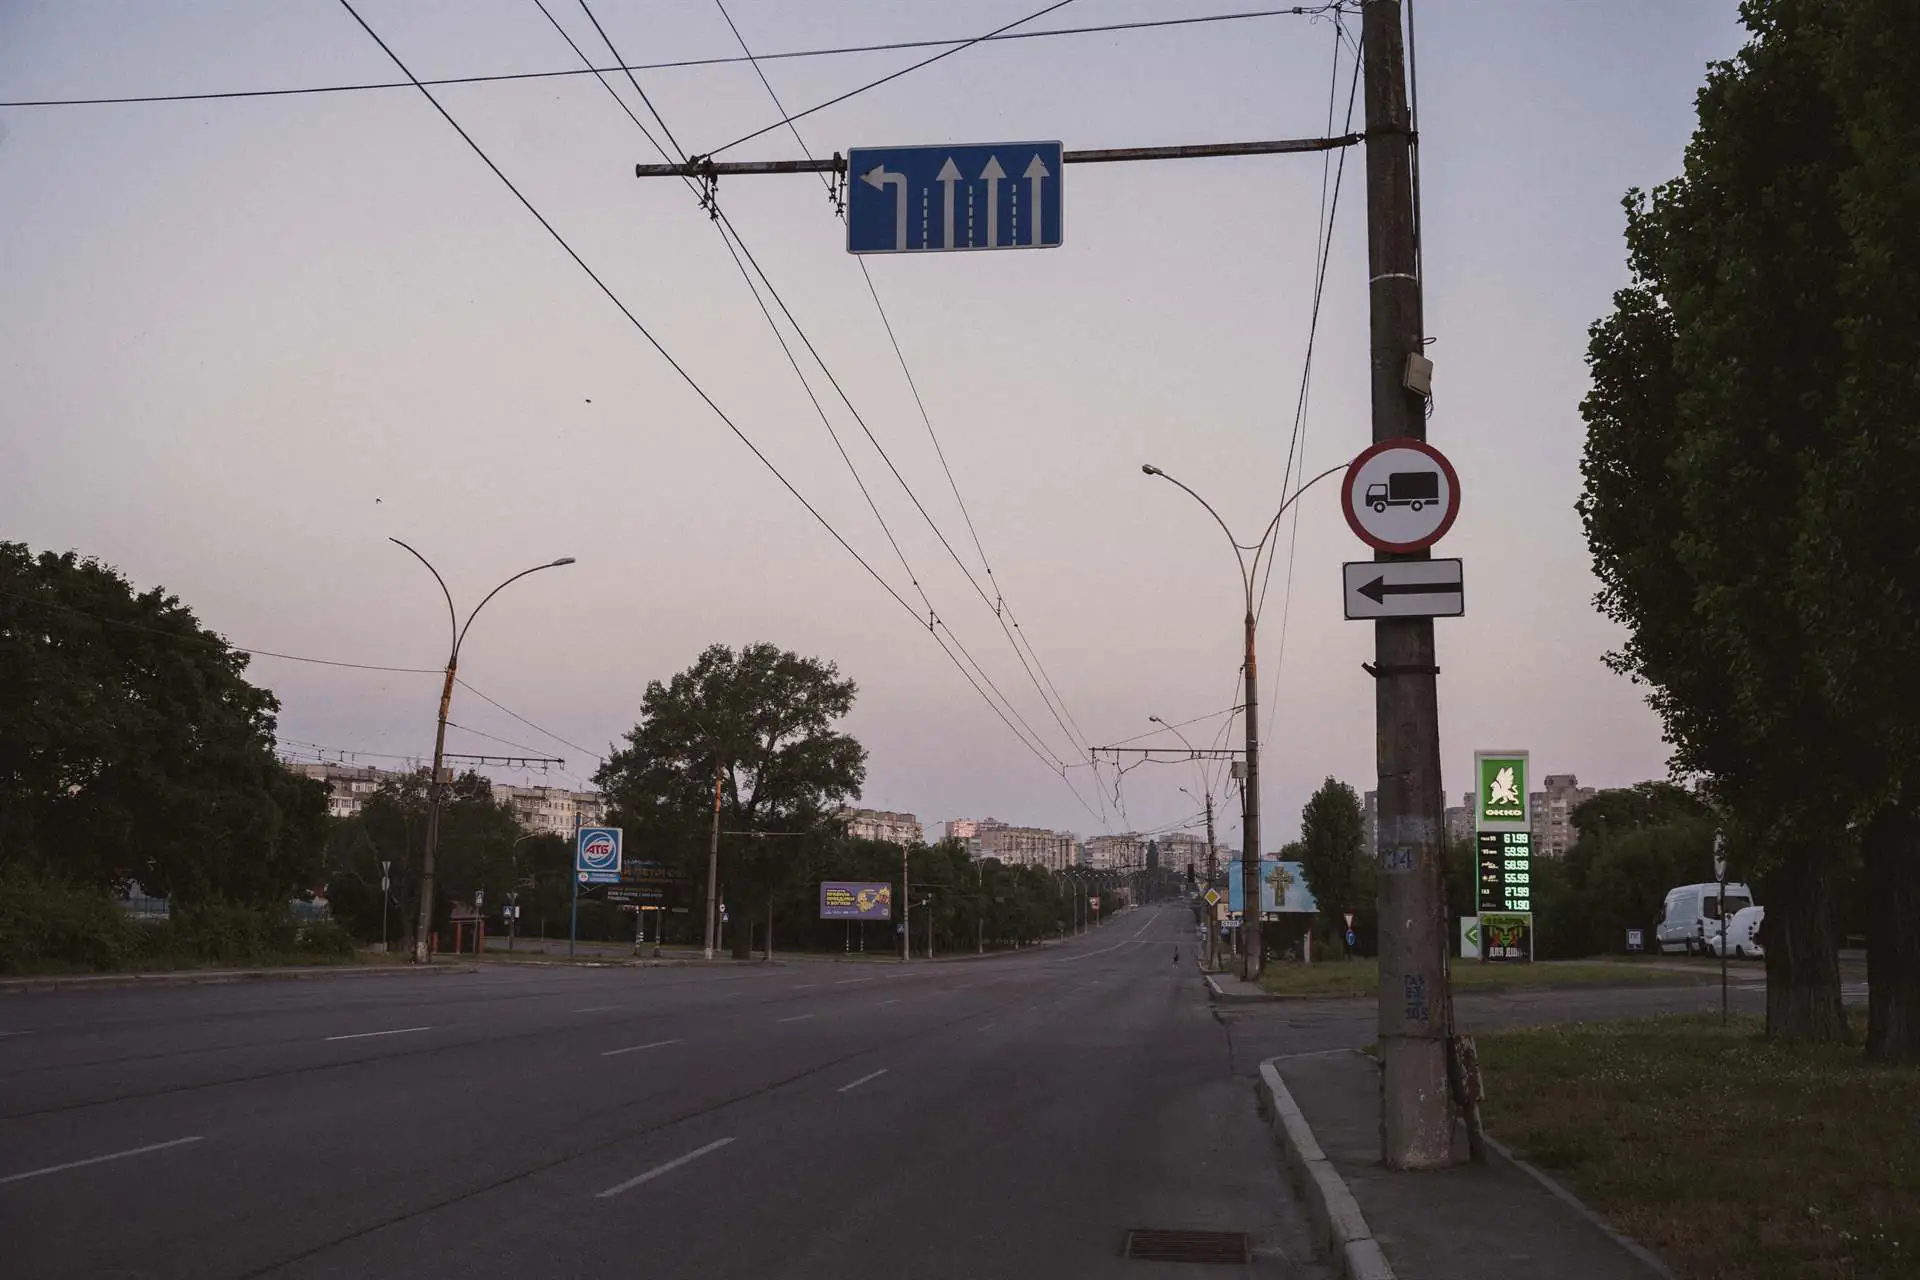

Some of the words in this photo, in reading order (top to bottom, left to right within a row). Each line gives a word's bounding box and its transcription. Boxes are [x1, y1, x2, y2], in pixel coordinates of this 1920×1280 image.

[1504, 834, 1528, 843] 61.99
[1504, 847, 1529, 856] 59.99
[1504, 860, 1529, 870] 58.99
[1504, 873, 1529, 883] 55.99
[1504, 887, 1530, 897] 27.99
